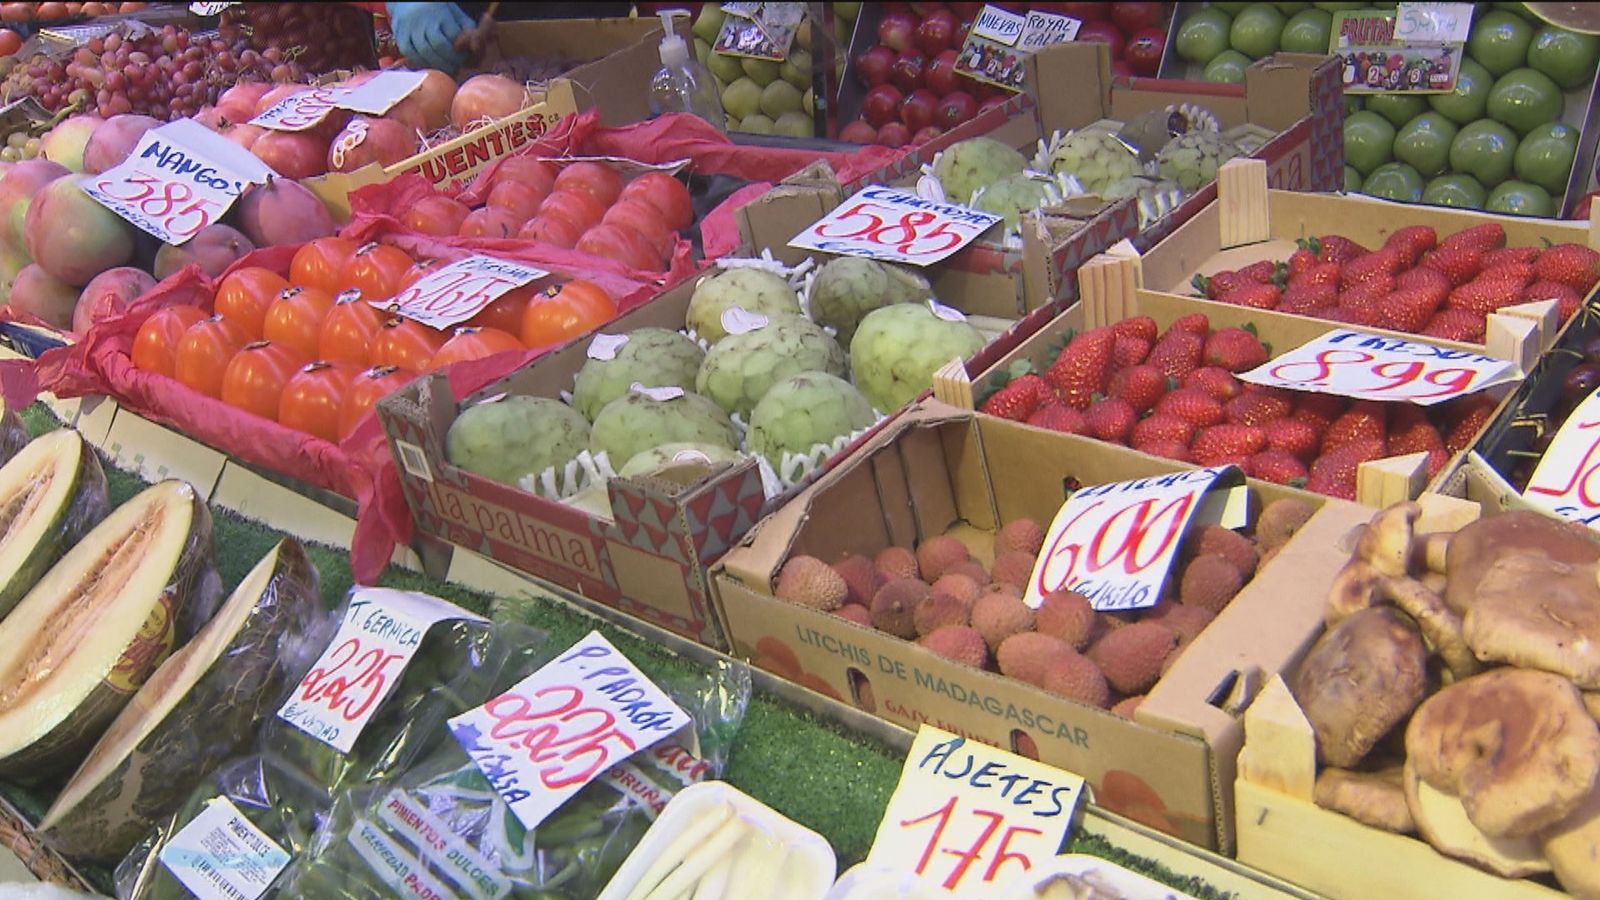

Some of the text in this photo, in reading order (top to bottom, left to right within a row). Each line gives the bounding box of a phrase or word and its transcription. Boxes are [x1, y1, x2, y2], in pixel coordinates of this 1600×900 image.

[1027, 14, 1071, 32] ROYAL
[473, 501, 595, 573] palma
[796, 625, 872, 666] LITCHIS
[878, 654, 908, 680] DE
[914, 668, 1090, 749] MADAGASCAR
[919, 738, 1071, 817] AJETES
[387, 798, 500, 898] PIMIENTOS DULCES
